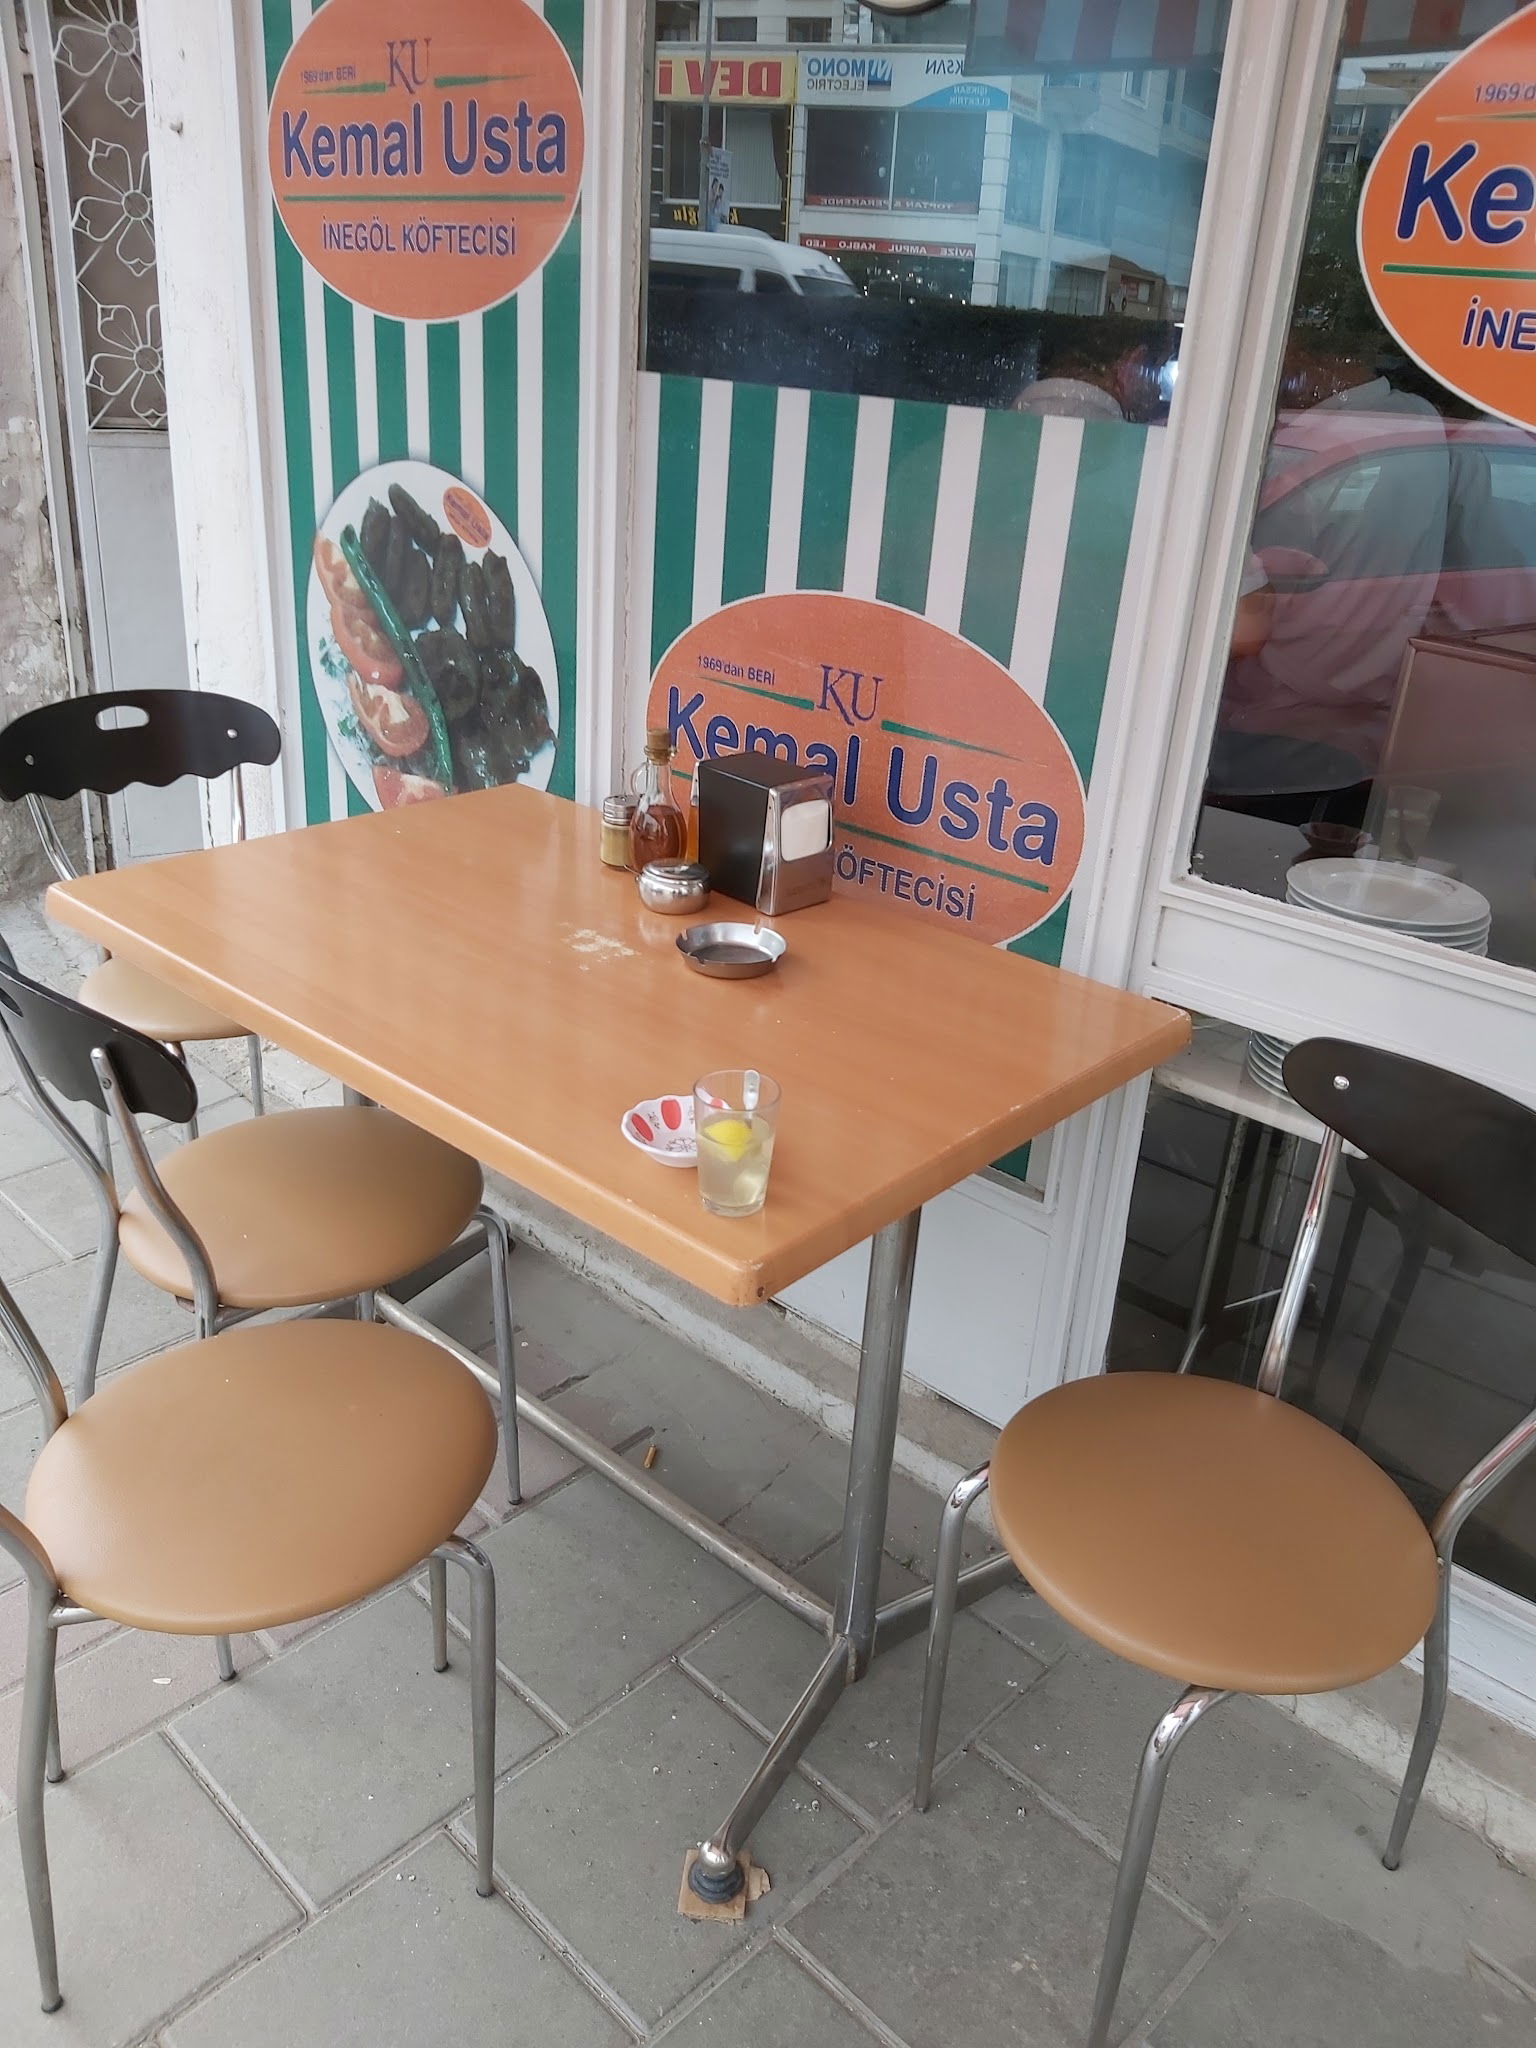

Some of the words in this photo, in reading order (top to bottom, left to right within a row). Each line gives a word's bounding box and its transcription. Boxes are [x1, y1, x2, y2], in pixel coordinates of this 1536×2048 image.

[385, 37, 432, 95] KU
[282, 101, 423, 178] Kemal
[443, 97, 567, 176] Usta
[322, 215, 396, 251] İNEGÖL
[402, 215, 517, 256] KÖFTECİSİ
[697, 655, 745, 679] 1969'dan
[747, 666, 776, 686] BERİ
[816, 663, 884, 727] KU
[886, 746, 1060, 867] Usta
[834, 843, 978, 922] ÖFTECİSİ
